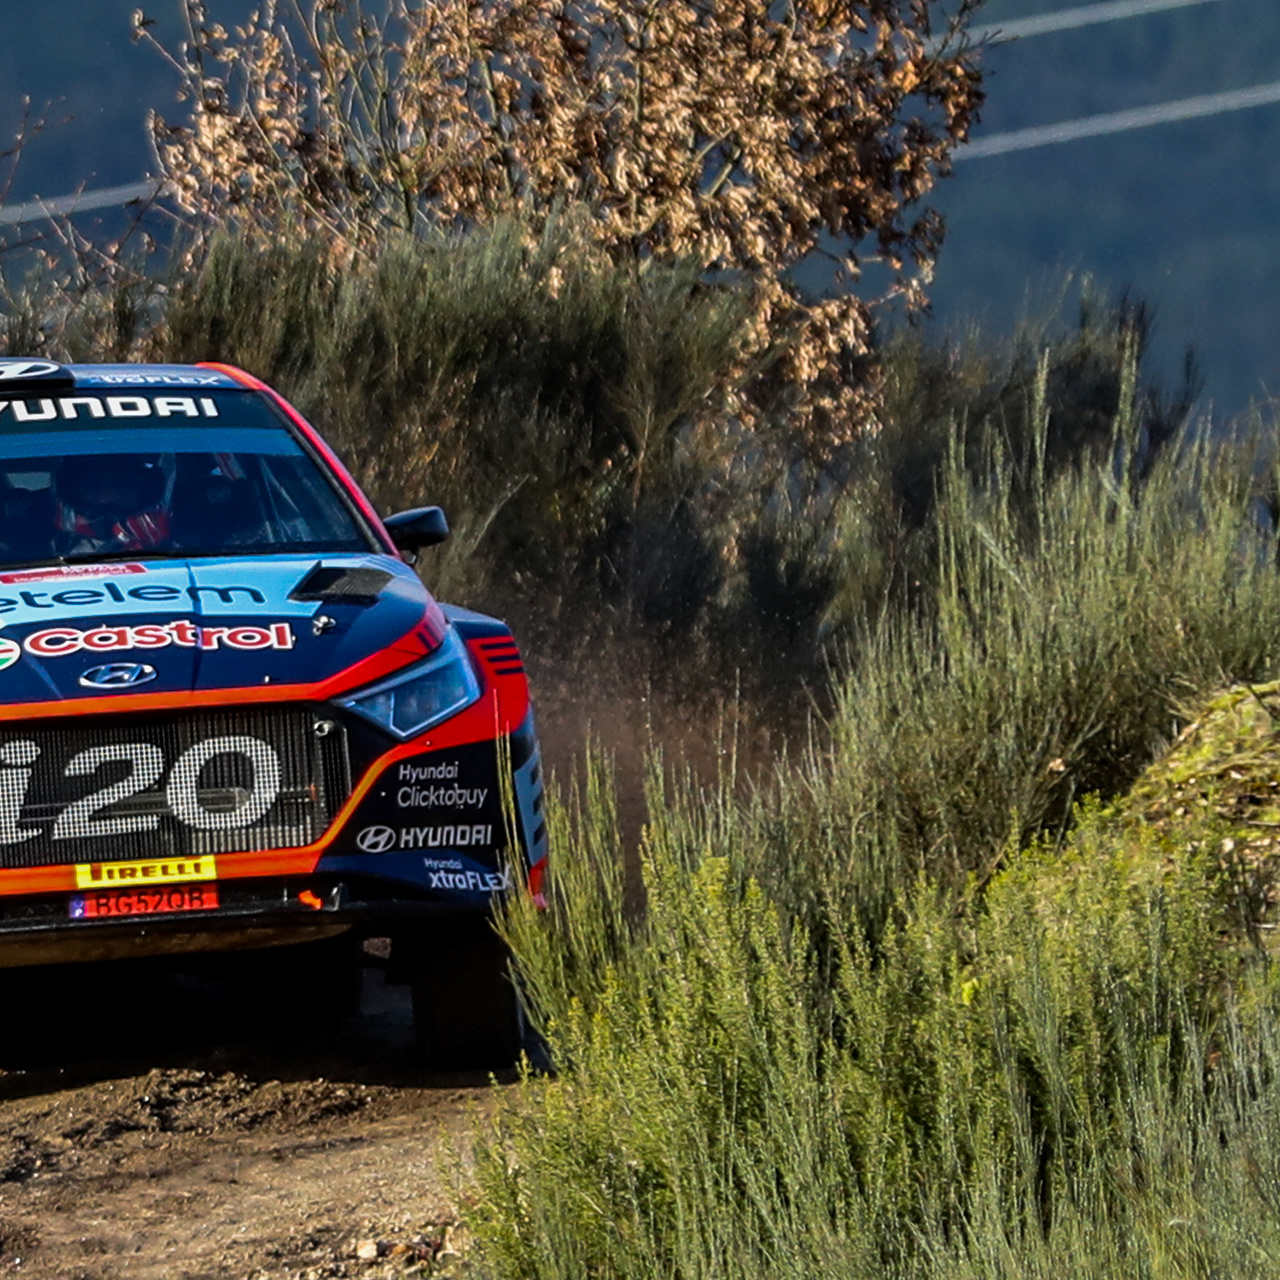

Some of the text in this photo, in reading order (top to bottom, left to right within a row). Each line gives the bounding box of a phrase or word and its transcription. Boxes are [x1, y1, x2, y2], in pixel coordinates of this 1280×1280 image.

[23, 620, 295, 658] Castrol
[398, 761, 459, 783] Hyundai
[397, 783, 489, 809] Clicktobuy
[399, 824, 493, 849] HYUNDAI
[90, 856, 203, 881] PIRELLI
[423, 857, 463, 870] Hyundai
[428, 863, 515, 892] xtraFLEX
